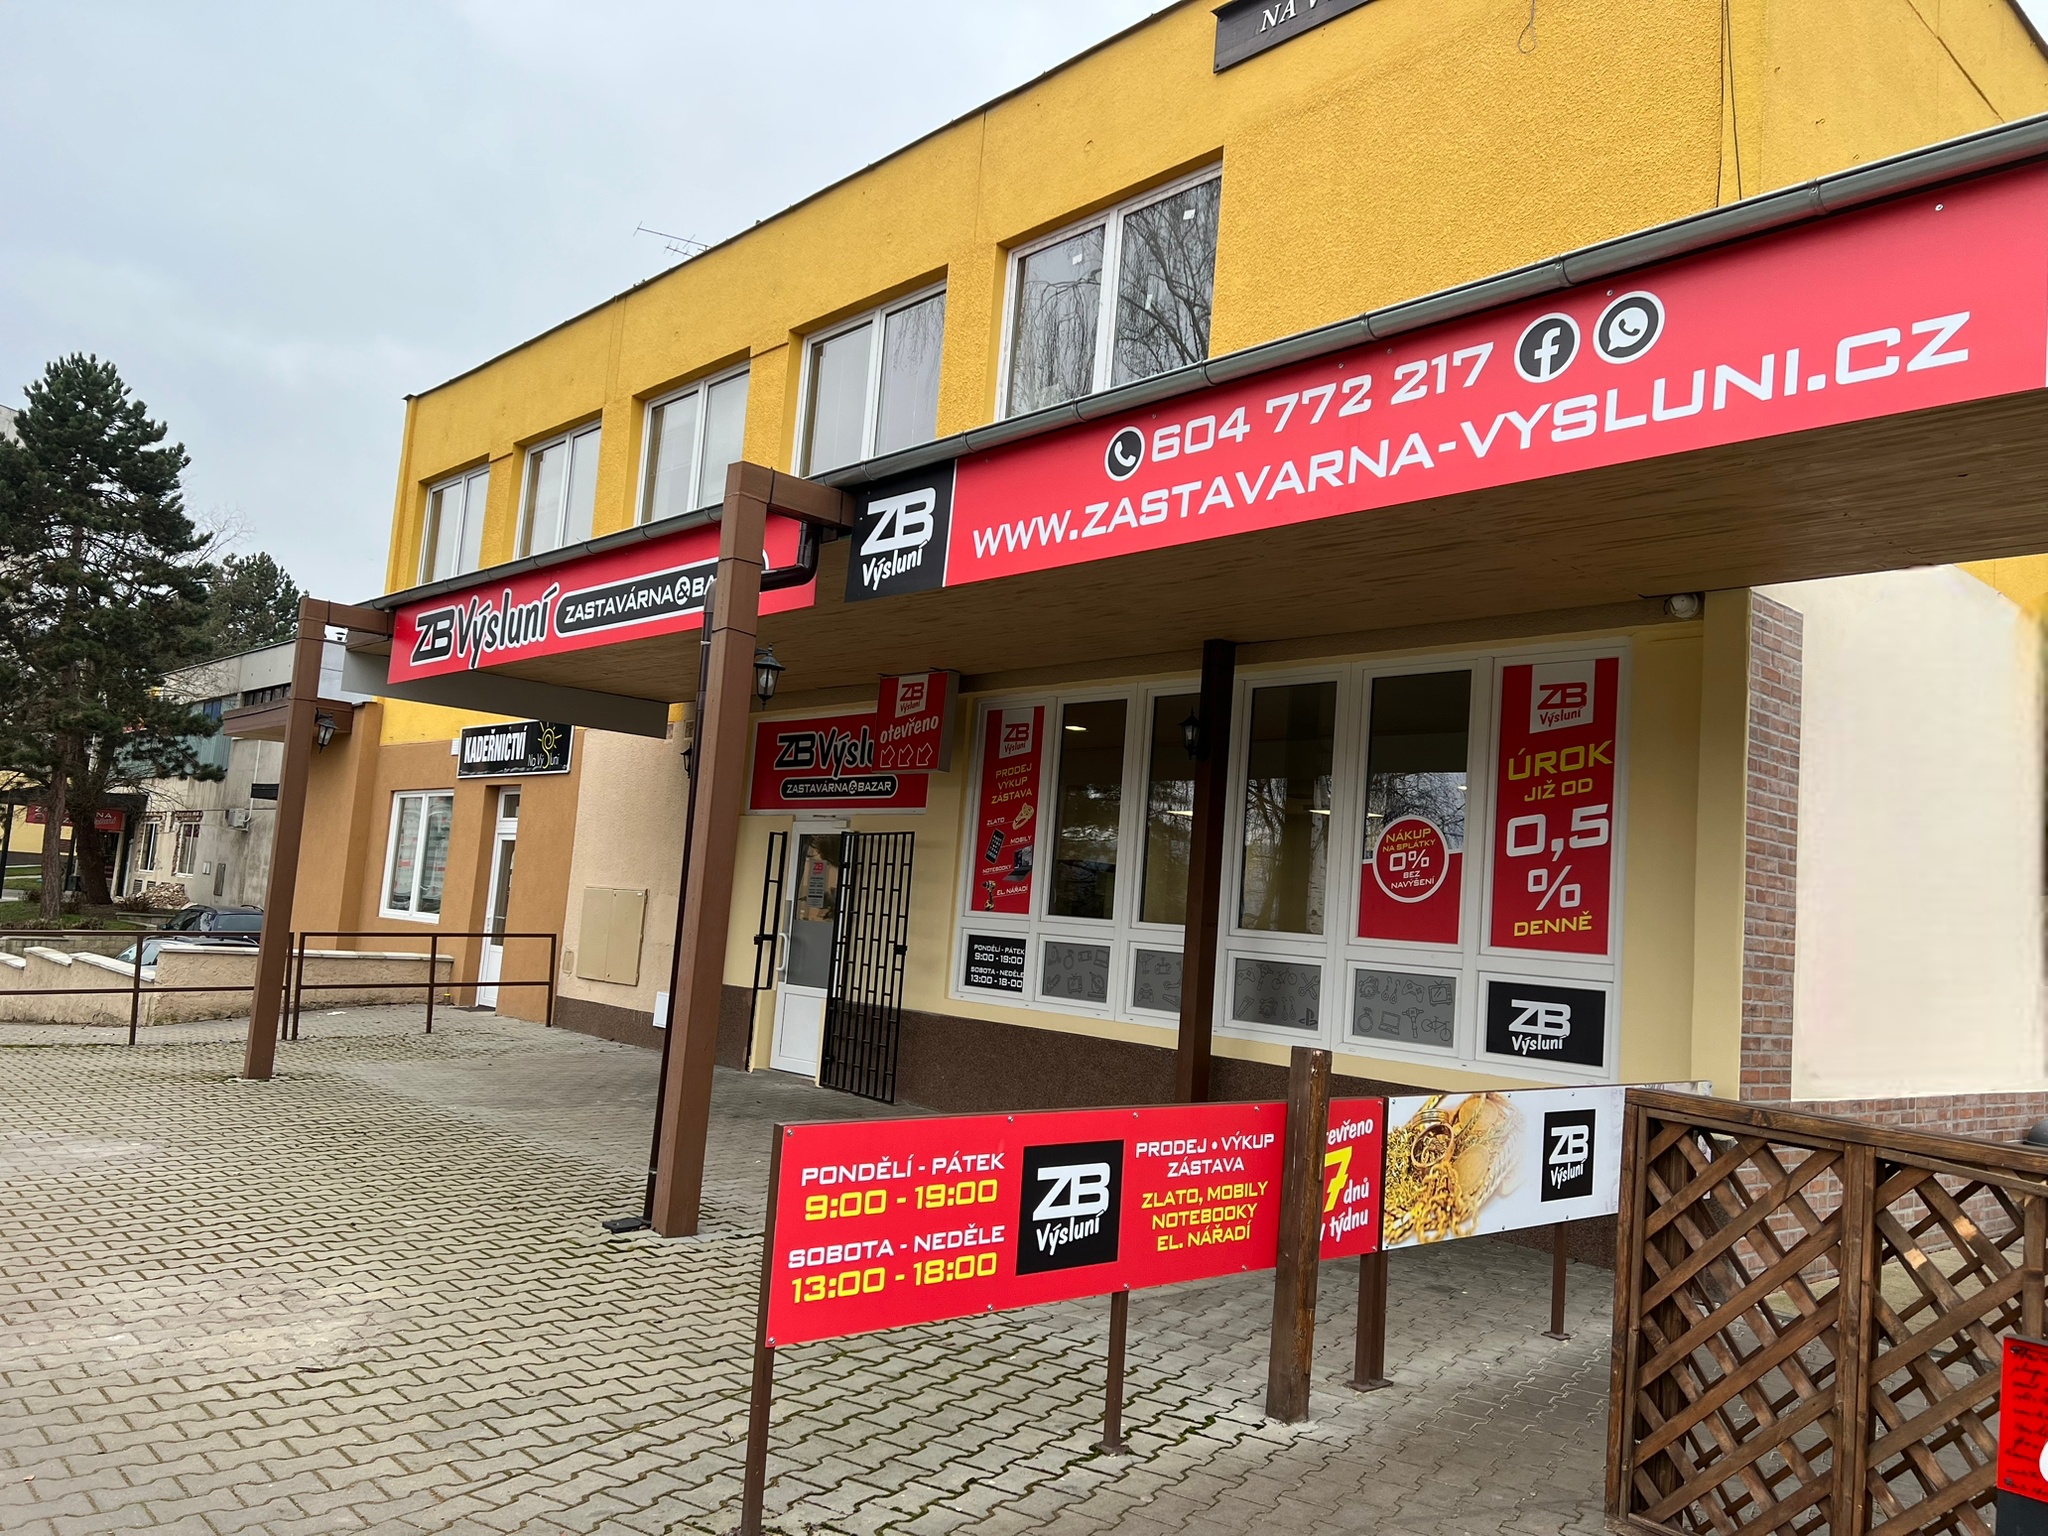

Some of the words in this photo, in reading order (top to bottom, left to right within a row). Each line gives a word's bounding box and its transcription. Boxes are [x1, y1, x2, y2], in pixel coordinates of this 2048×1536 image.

[1260, 0, 1297, 33] NA
[1151, 408, 1251, 462] 604
[1265, 374, 1373, 434] 772
[1389, 341, 1494, 406] 217
[859, 486, 937, 556] ZB
[861, 540, 929, 591] Výsluní
[410, 606, 456, 665] ZB
[457, 583, 558, 669] Výsluní
[899, 681, 925, 702] ZB
[1537, 681, 1588, 710] ZB
[879, 715, 939, 744] otevřeno
[1539, 706, 1583, 728] Výsluní
[463, 725, 528, 764] KADEŘNICTVÍ
[1003, 722, 1030, 743] ZB
[774, 731, 817, 770] ZB
[1507, 739, 1614, 781] ÚROK
[995, 762, 1033, 780] PRODEJ
[997, 776, 1028, 791] VÝKUP
[991, 788, 1033, 805] ZÁSTAVA
[1524, 779, 1556, 802] JIŽ
[1561, 777, 1594, 797] OD
[986, 816, 1005, 826] ZLATO
[1385, 827, 1432, 844] NÁKUP
[1505, 803, 1610, 862] 0,5
[1010, 835, 1032, 844] MOBILY
[1382, 844, 1395, 853] NA
[1396, 838, 1437, 851] SPLÁTKY
[982, 864, 1012, 874] NOTEBOOKY
[1389, 849, 1430, 872] 0%
[1402, 870, 1421, 879] BEZ
[1390, 875, 1435, 890] NAVÝŠENÍ
[1527, 865, 1582, 911] %
[1513, 910, 1593, 937] DENNĚ
[973, 943, 1001, 953] PONDĚLÍ
[1004, 946, 1025, 955] PÁTEK
[974, 952, 994, 962] 9:00
[1000, 955, 1023, 965] 19:00
[970, 966, 996, 975] SOBOTA
[970, 974, 993, 984] 13:00
[1508, 999, 1572, 1037] ZB
[1511, 1034, 1567, 1056] Výsluní
[1136, 1138, 1207, 1158] PRODEJ
[1221, 1131, 1275, 1151] VÝKUP
[1326, 1118, 1374, 1146] evřeno
[1549, 1124, 1589, 1165] ZB
[801, 1154, 915, 1187] PONDĚLÍ
[931, 1151, 1005, 1175] PÁTEK
[1167, 1156, 1245, 1178] ZÁSTAVA
[1324, 1145, 1353, 1213] 7
[1550, 1159, 1585, 1189] Výsluní
[804, 1189, 887, 1222] 9:00
[914, 1178, 998, 1210] 19:00
[1032, 1162, 1112, 1222] ZB
[1141, 1188, 1203, 1209] ZLATO,
[1207, 1180, 1269, 1202] MOBILY
[1343, 1177, 1370, 1205] dnů
[1152, 1202, 1258, 1231] NOTEBOOKY
[1329, 1206, 1369, 1243] týdnu
[788, 1239, 894, 1269] SOBOTA
[913, 1223, 1005, 1253] NEDĚLE
[1036, 1209, 1104, 1256] Výsluní
[1157, 1235, 1184, 1252] EL.
[1187, 1219, 1252, 1248] NÁŘADÍ
[791, 1267, 886, 1304] 13:00
[913, 1252, 998, 1286] 18:00
